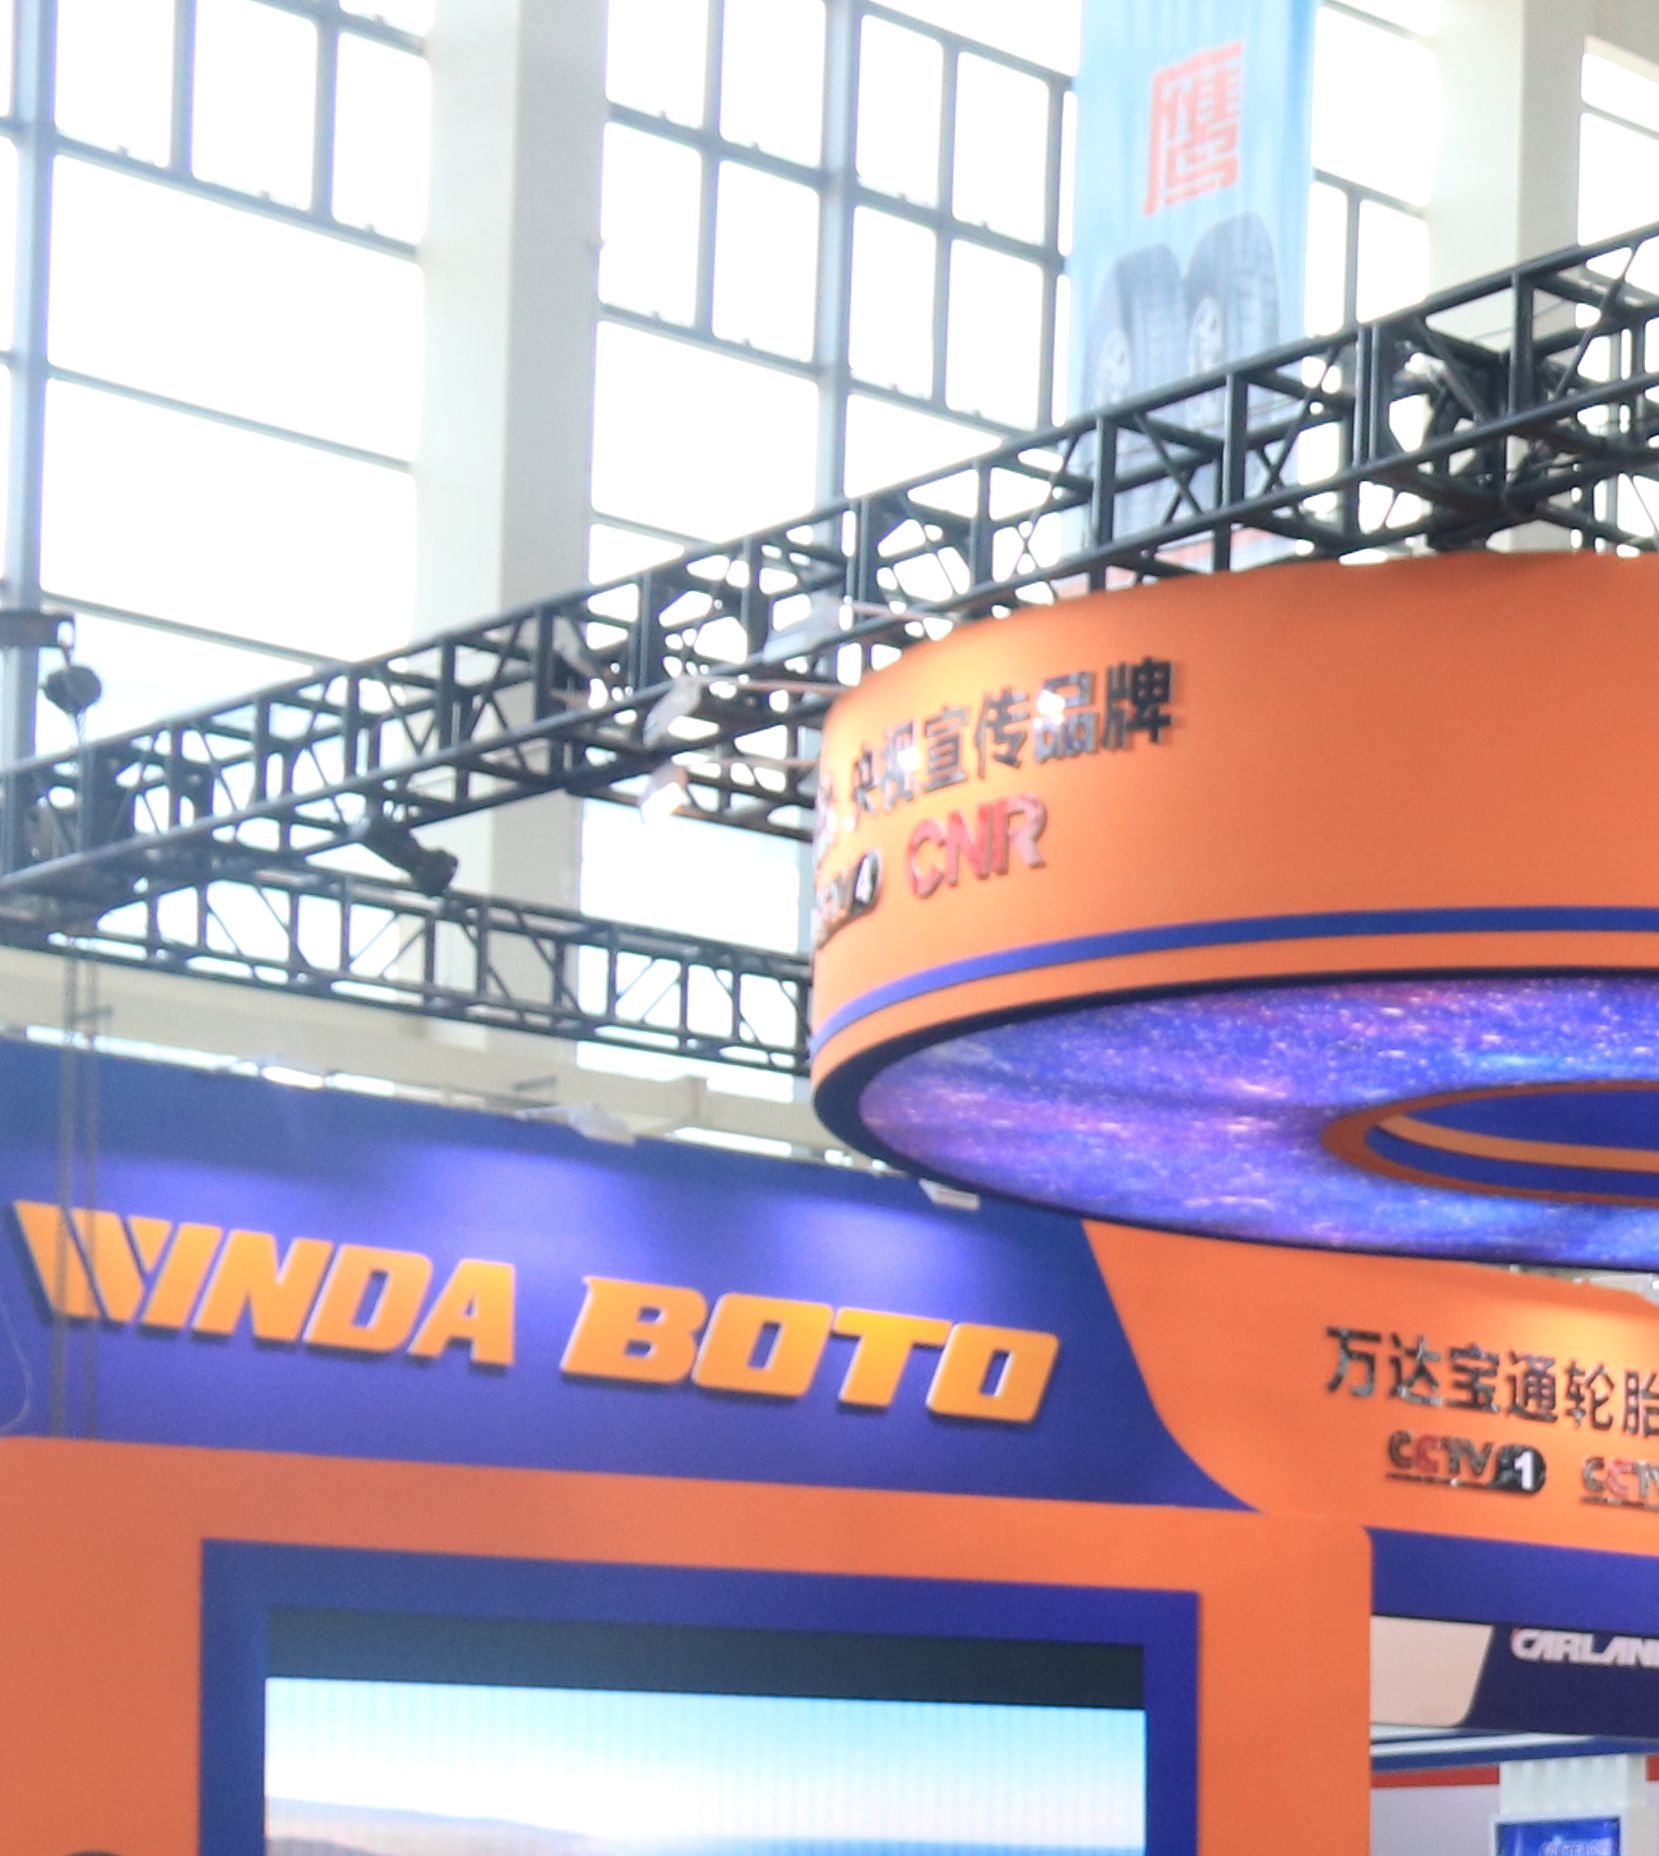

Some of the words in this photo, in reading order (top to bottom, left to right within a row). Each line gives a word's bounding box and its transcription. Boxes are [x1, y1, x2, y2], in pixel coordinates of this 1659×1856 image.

[905, 792, 1048, 898] CNR
[12, 1201, 516, 1367] WINDA
[560, 1275, 1060, 1423] BOTO
